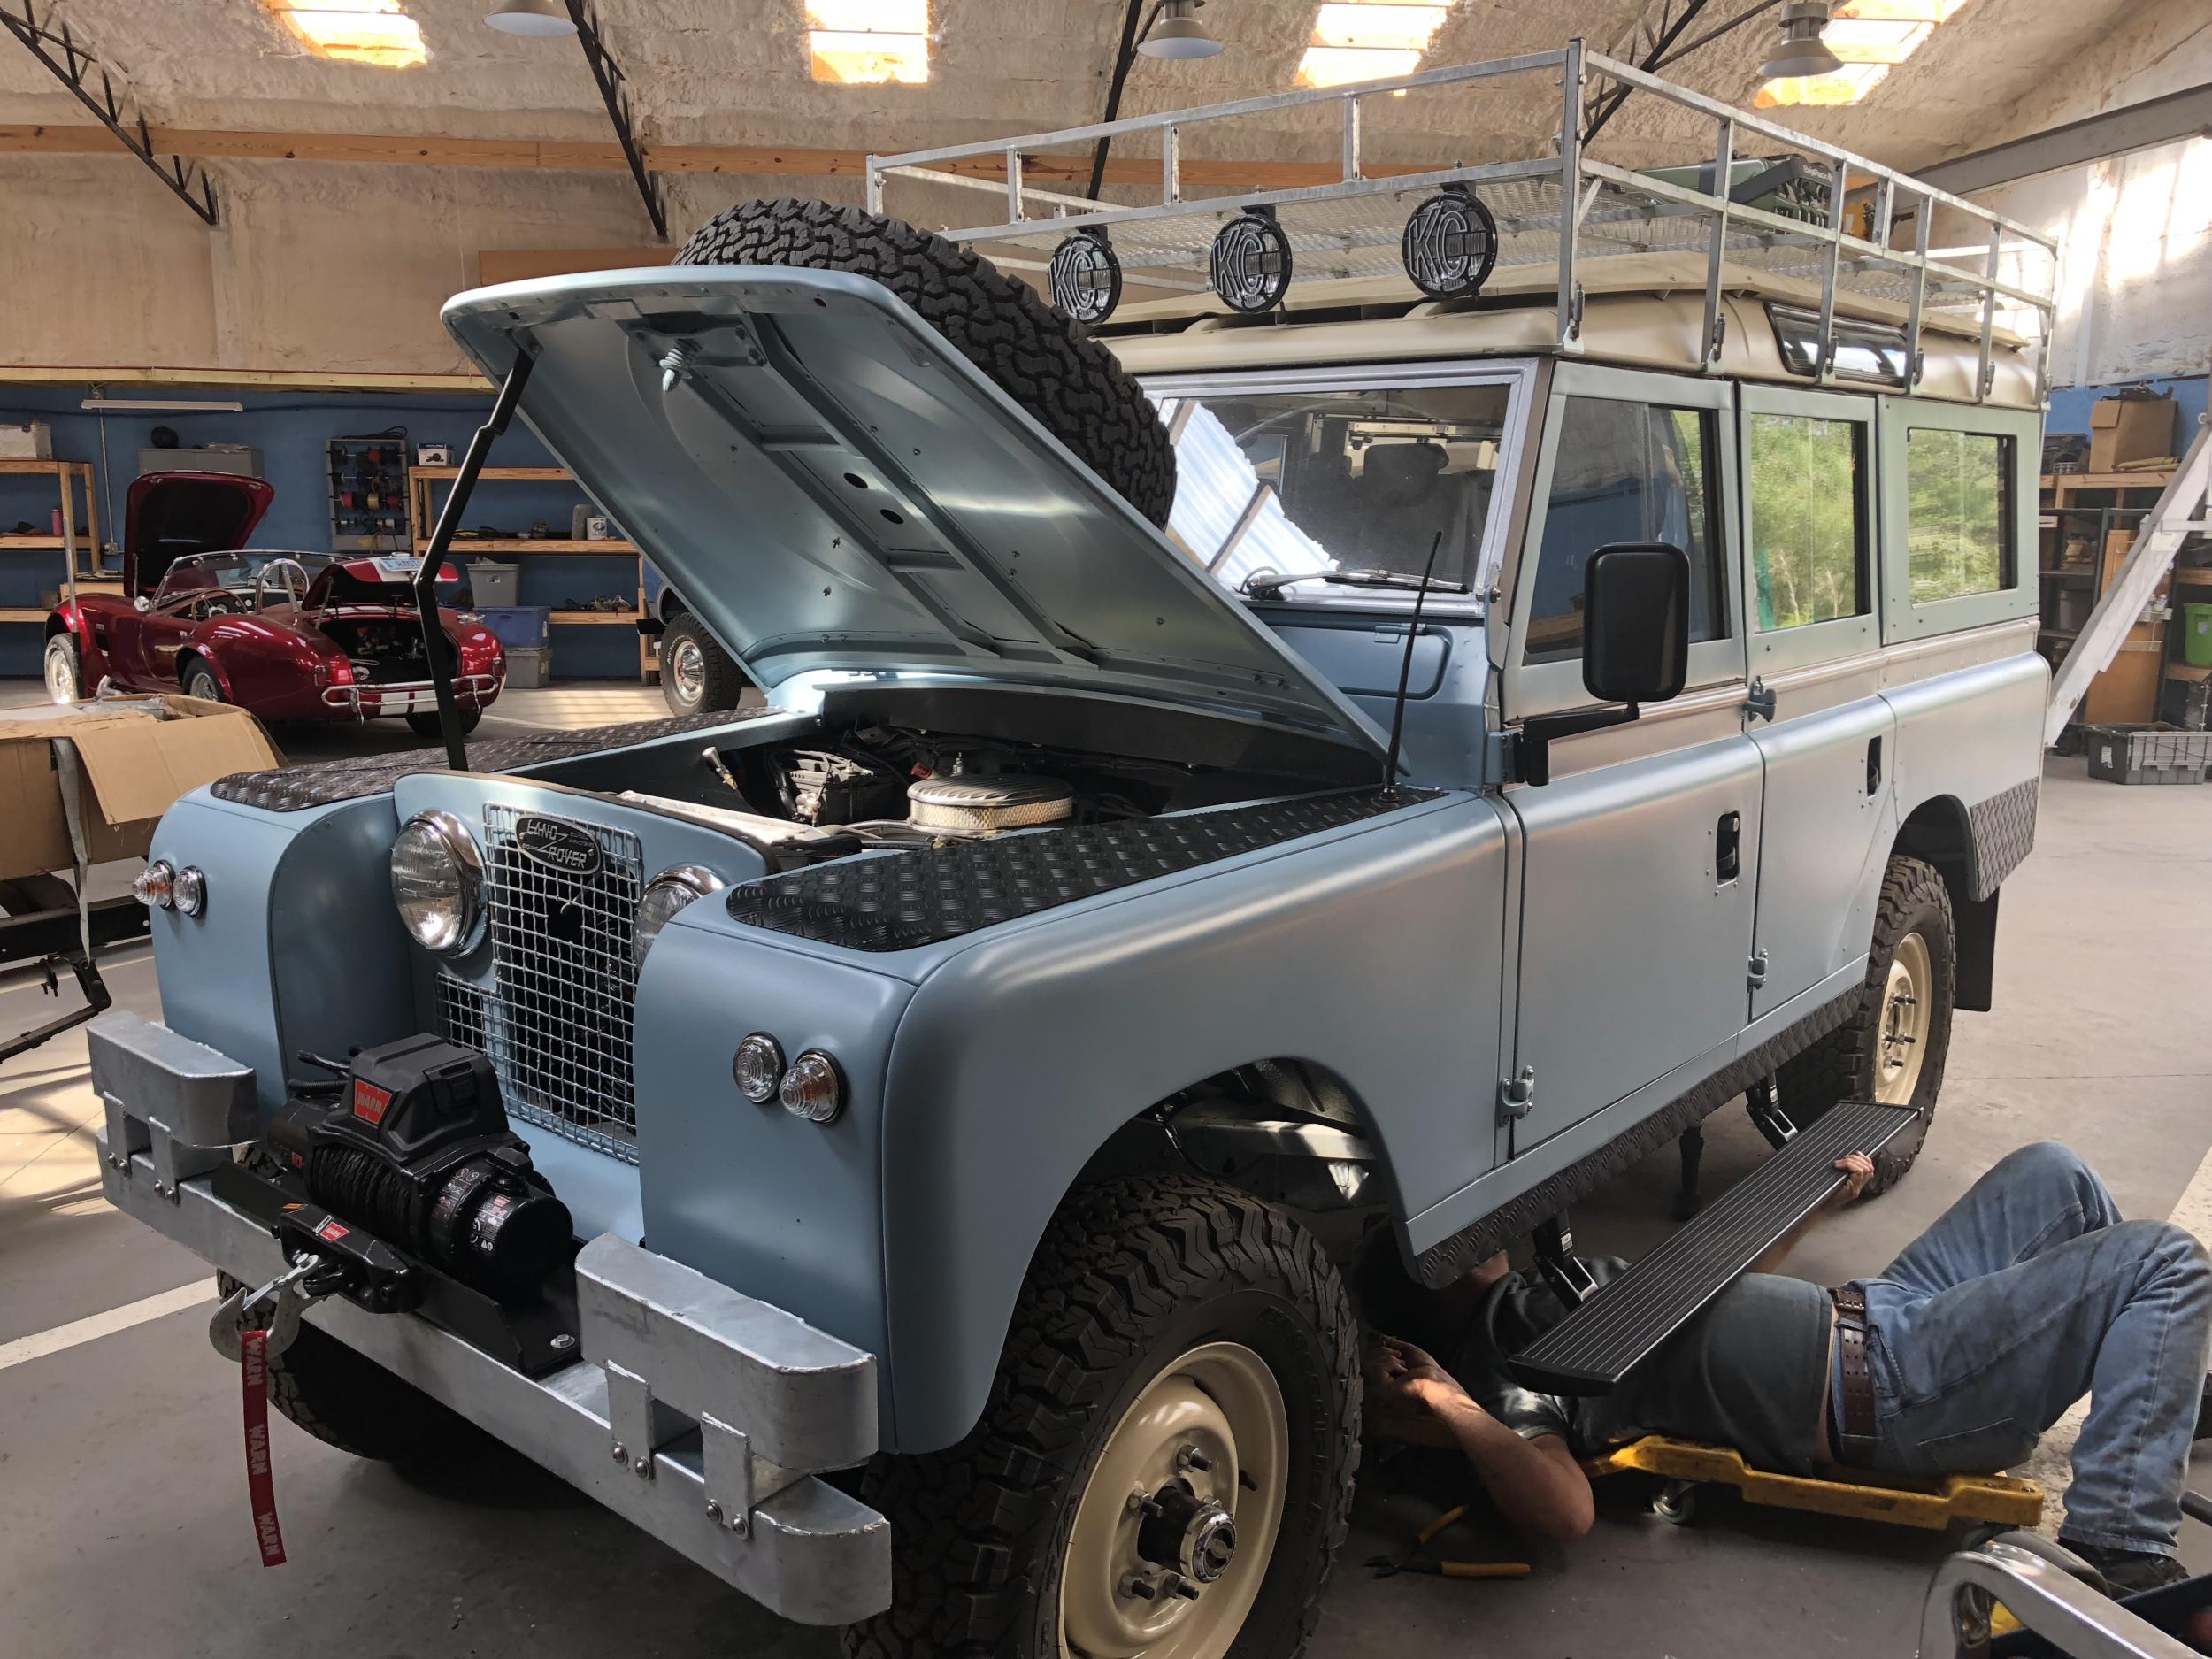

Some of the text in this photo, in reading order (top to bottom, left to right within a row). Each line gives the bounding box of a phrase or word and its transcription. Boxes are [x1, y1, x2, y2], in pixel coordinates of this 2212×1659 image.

[1212, 227, 1263, 303] KC
[1409, 204, 1468, 286] KC
[1048, 245, 1094, 318] KC
[526, 819, 558, 841] LAND
[547, 846, 587, 869] ROVER
[357, 1091, 383, 1113] WARN
[246, 1336, 264, 1386] WARN
[249, 1423, 268, 1476] WARN
[257, 1510, 280, 1557] WARN
